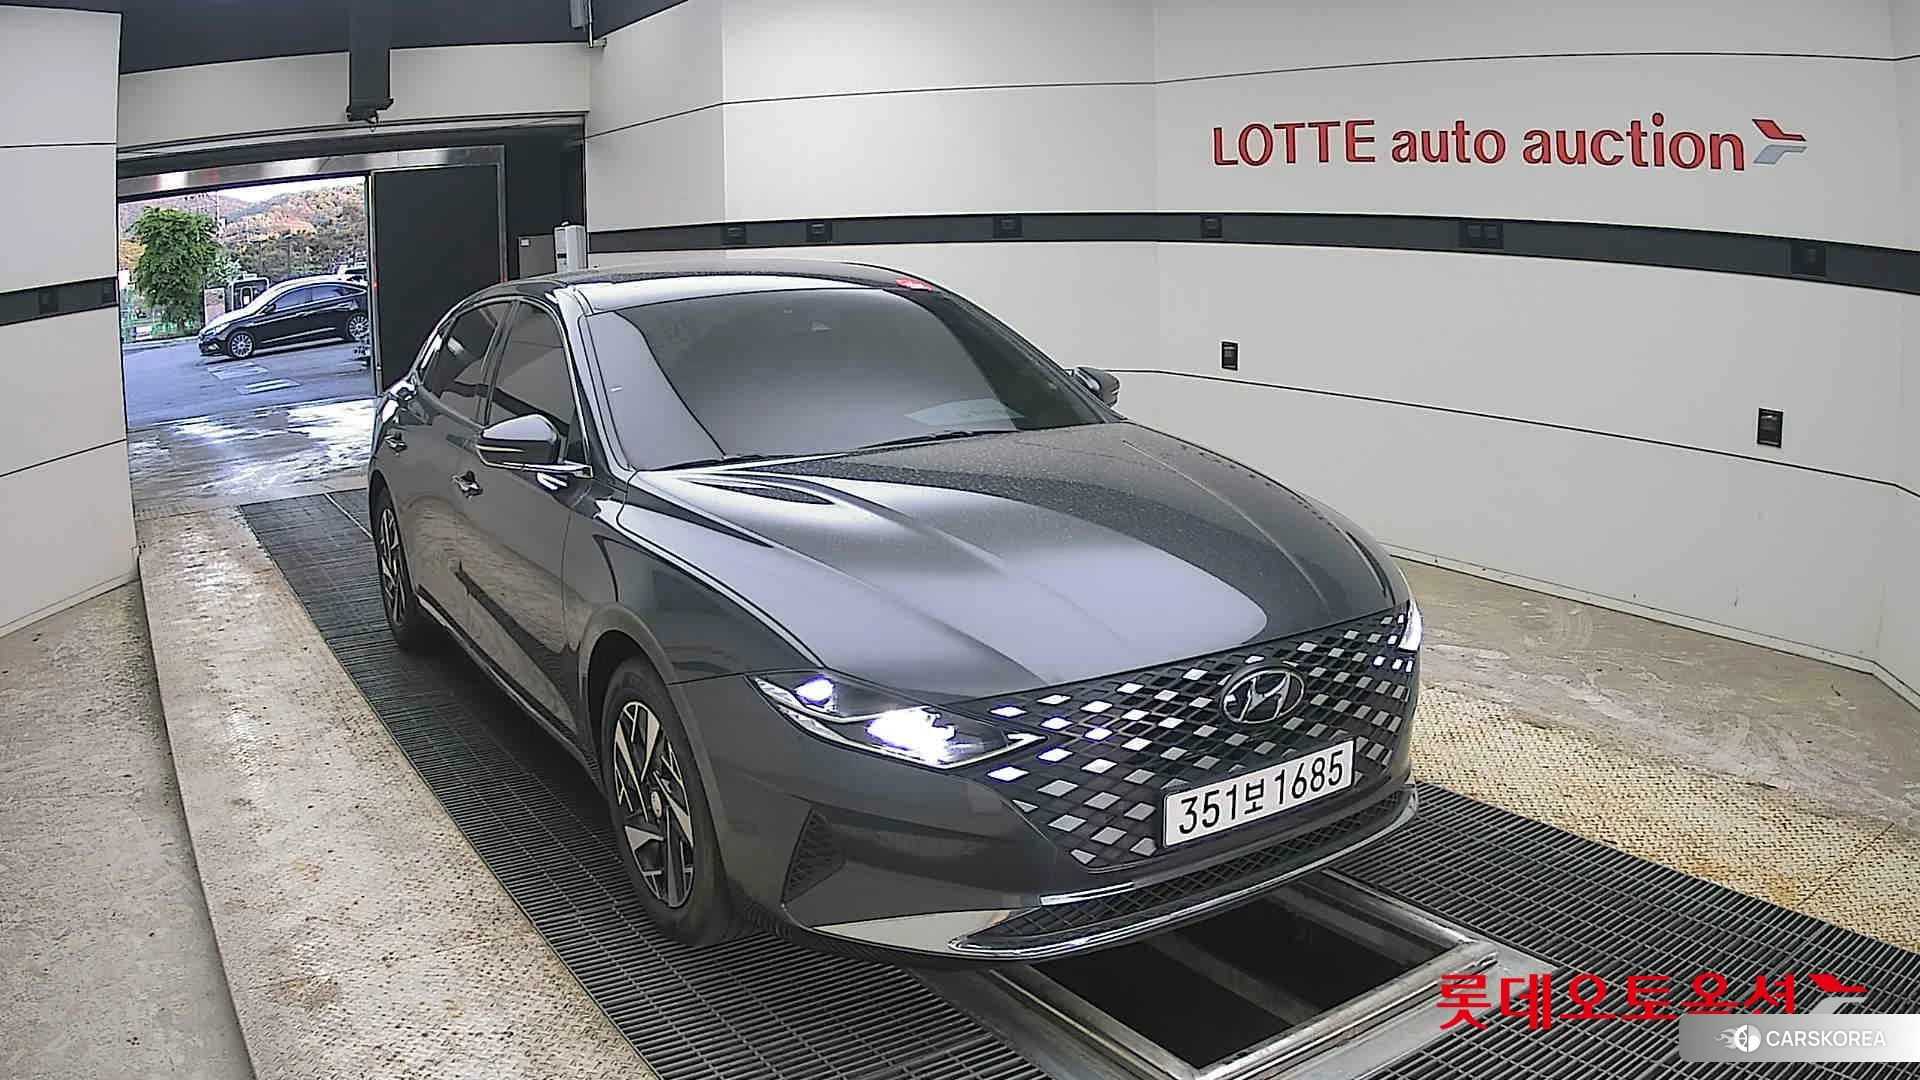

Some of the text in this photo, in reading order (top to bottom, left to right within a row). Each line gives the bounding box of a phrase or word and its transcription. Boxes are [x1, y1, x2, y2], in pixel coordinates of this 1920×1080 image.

[1213, 112, 1745, 171] LOTTE auto auction
